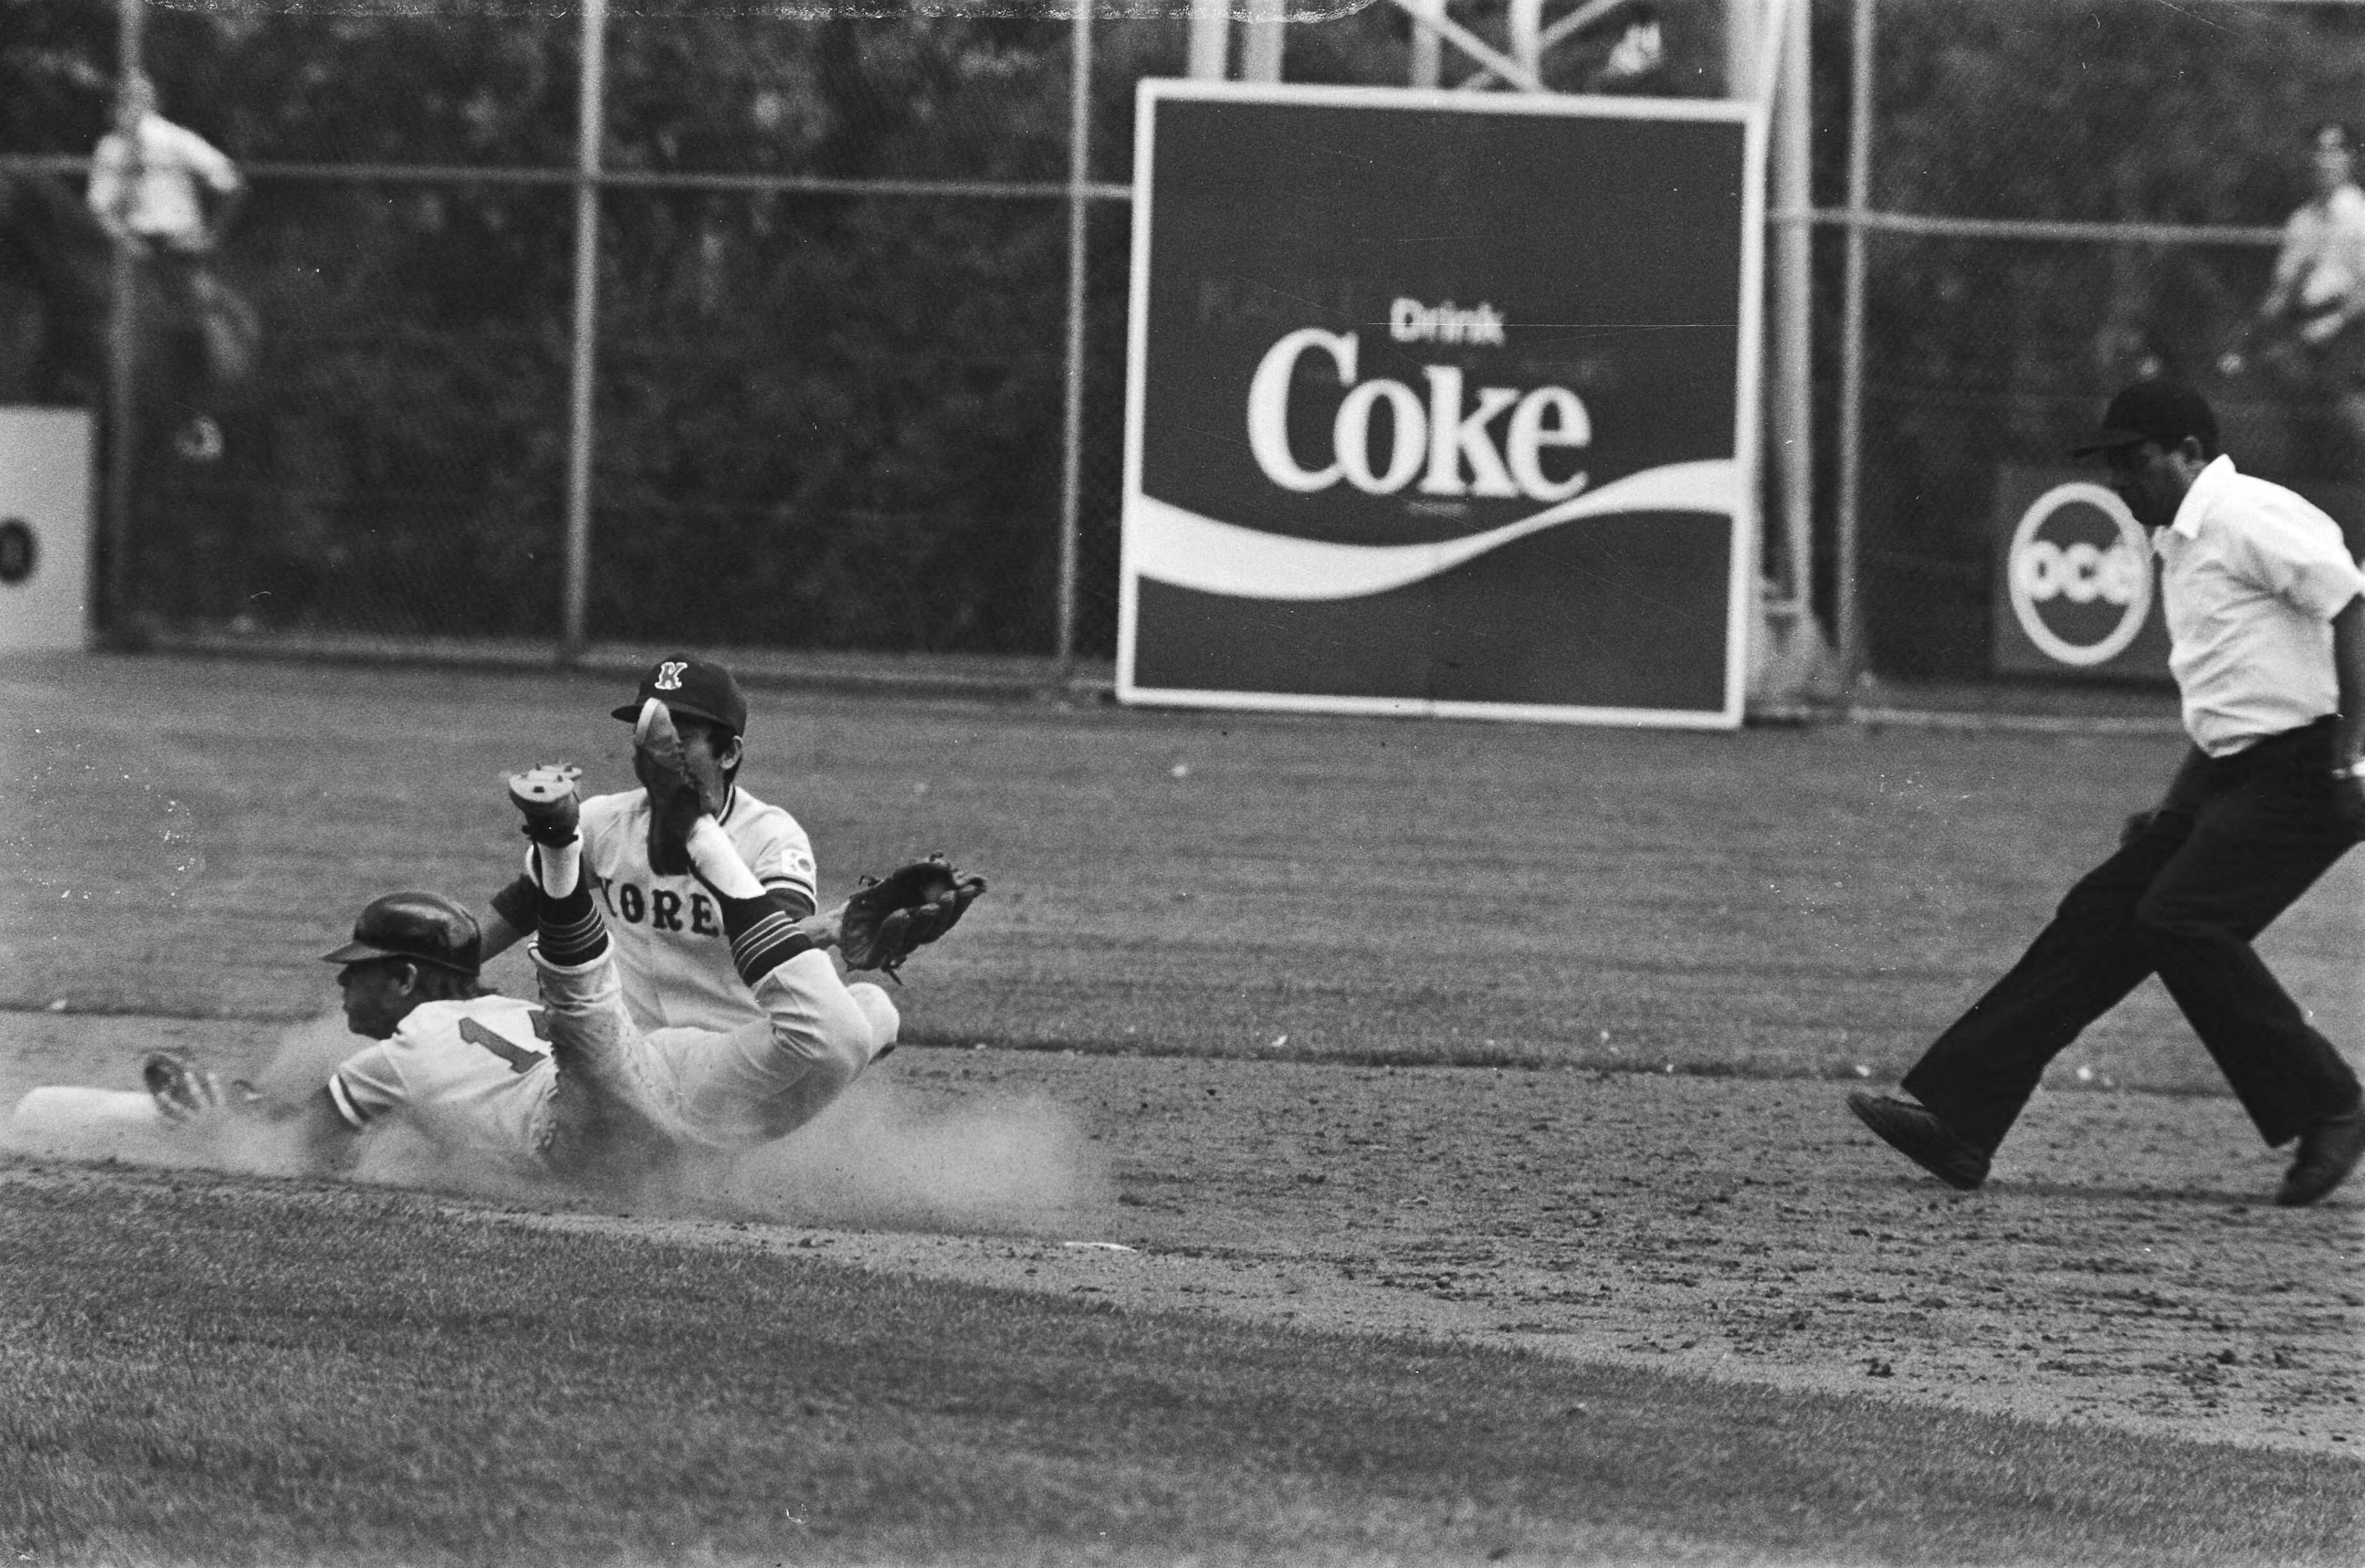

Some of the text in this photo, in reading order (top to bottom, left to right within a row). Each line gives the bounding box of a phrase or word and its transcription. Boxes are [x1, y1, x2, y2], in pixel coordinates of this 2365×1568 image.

[1389, 297, 1504, 346] Drink
[1247, 328, 1590, 502] Coke
[654, 661, 688, 690] K
[458, 1009, 549, 1074] 1
